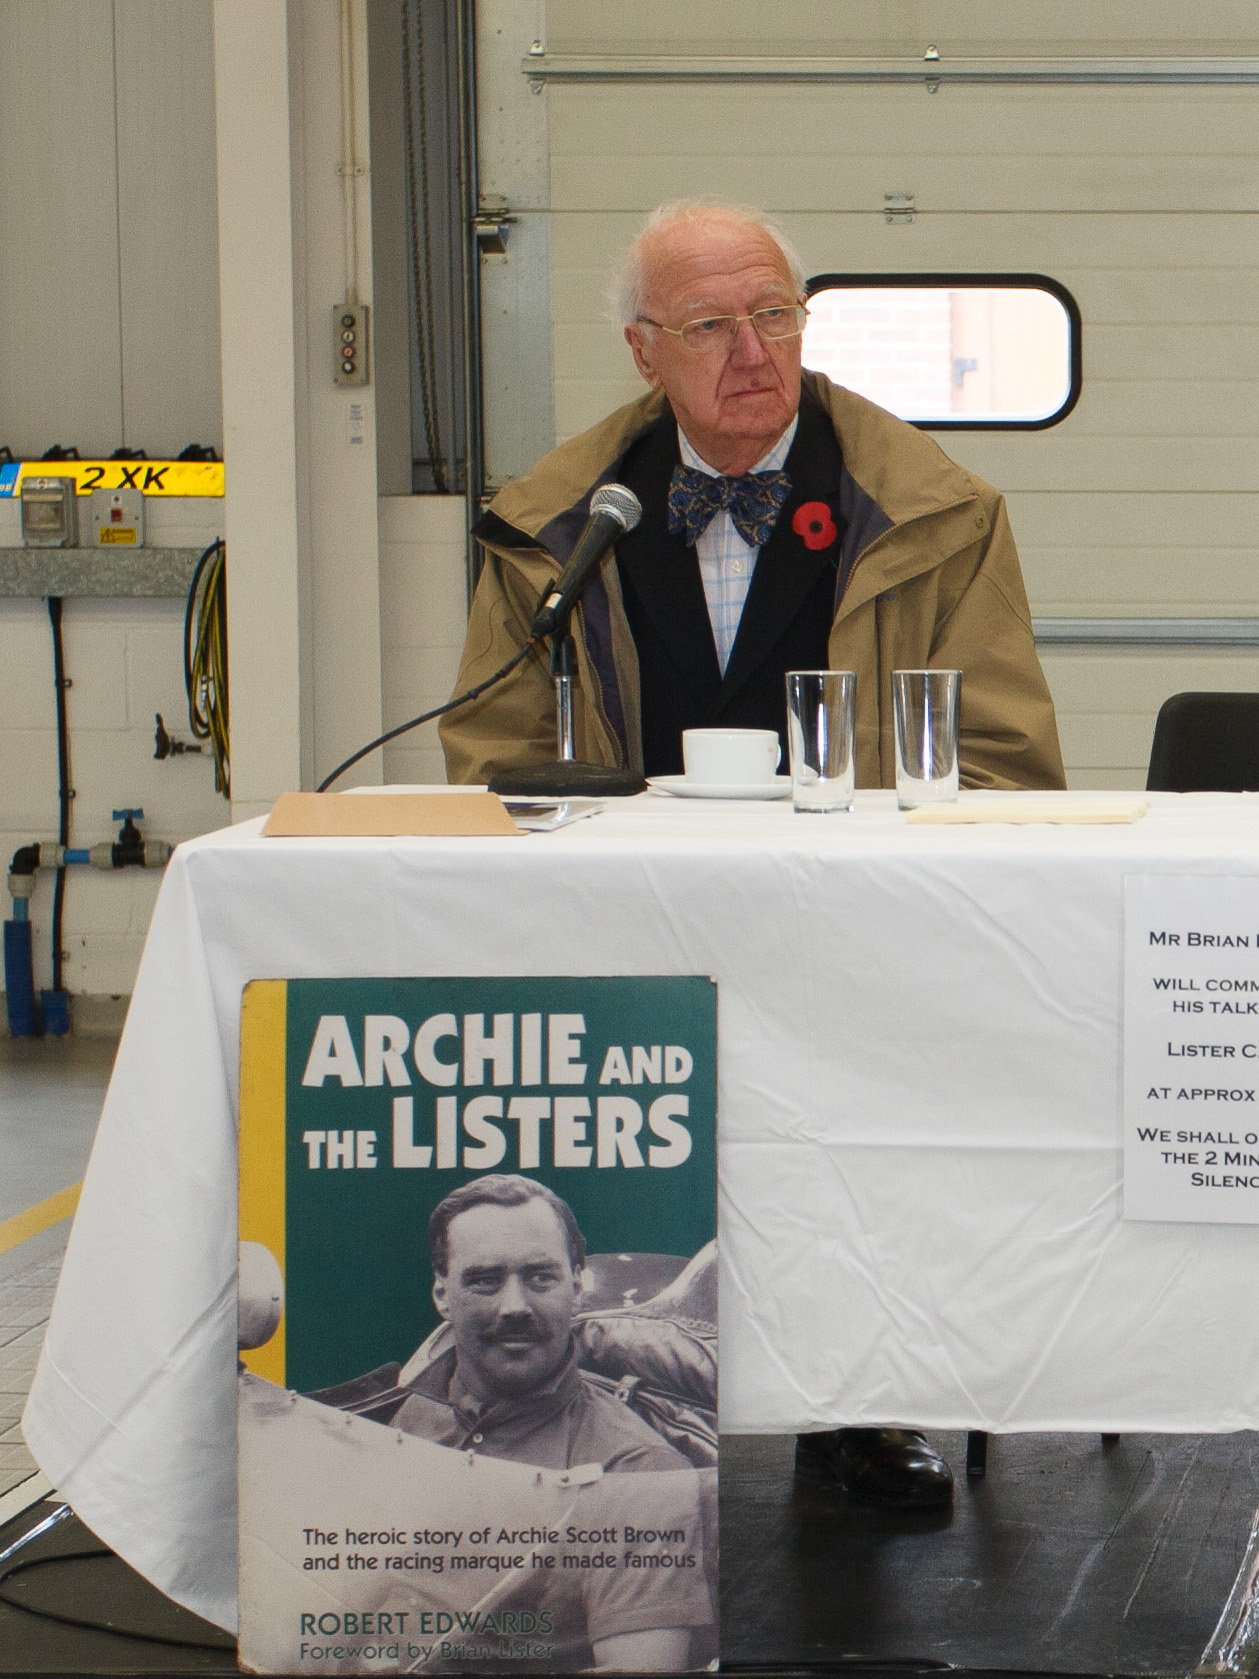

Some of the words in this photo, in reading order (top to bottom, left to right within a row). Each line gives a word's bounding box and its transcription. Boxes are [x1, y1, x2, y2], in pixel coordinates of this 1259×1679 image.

[80, 467, 105, 489] 2
[117, 467, 170, 489] XK
[1149, 931, 1181, 946] MR
[1187, 932, 1249, 948] BRIAN
[1153, 978, 1200, 991] WILL
[1172, 1000, 1204, 1014] HIS
[1209, 1001, 1258, 1015] TALK
[302, 1013, 587, 1087] ARCHIE
[599, 1046, 694, 1085] AND
[1167, 1042, 1236, 1058] LISTER
[1147, 1087, 1172, 1100] AT
[1177, 1088, 1255, 1102] APPROX
[302, 1130, 377, 1169] THE
[393, 1094, 692, 1169] LISTERS
[1136, 1127, 1171, 1142] WE
[1176, 1130, 1240, 1145] SHALL
[1161, 1151, 1199, 1165] THE
[1204, 1150, 1218, 1166] 2
[303, 1528, 337, 1546] The
[345, 1526, 407, 1546] heroic
[414, 1529, 463, 1549] story
[469, 1526, 491, 1545] of
[497, 1525, 559, 1544] Archie
[566, 1526, 617, 1544] Scott
[625, 1526, 685, 1543] Brown
[303, 1552, 339, 1571] and
[347, 1552, 378, 1570] the
[385, 1552, 443, 1574] racing
[450, 1552, 524, 1573] marque
[532, 1550, 555, 1569] he
[562, 1551, 616, 1569] made
[623, 1550, 696, 1569] famous
[300, 1612, 409, 1636] ROBERT
[420, 1611, 553, 1635] EDWARDS
[300, 1642, 399, 1661] Foreword
[406, 1642, 433, 1662] by
[441, 1641, 491, 1659] Brian
[501, 1642, 554, 1659] Lister
